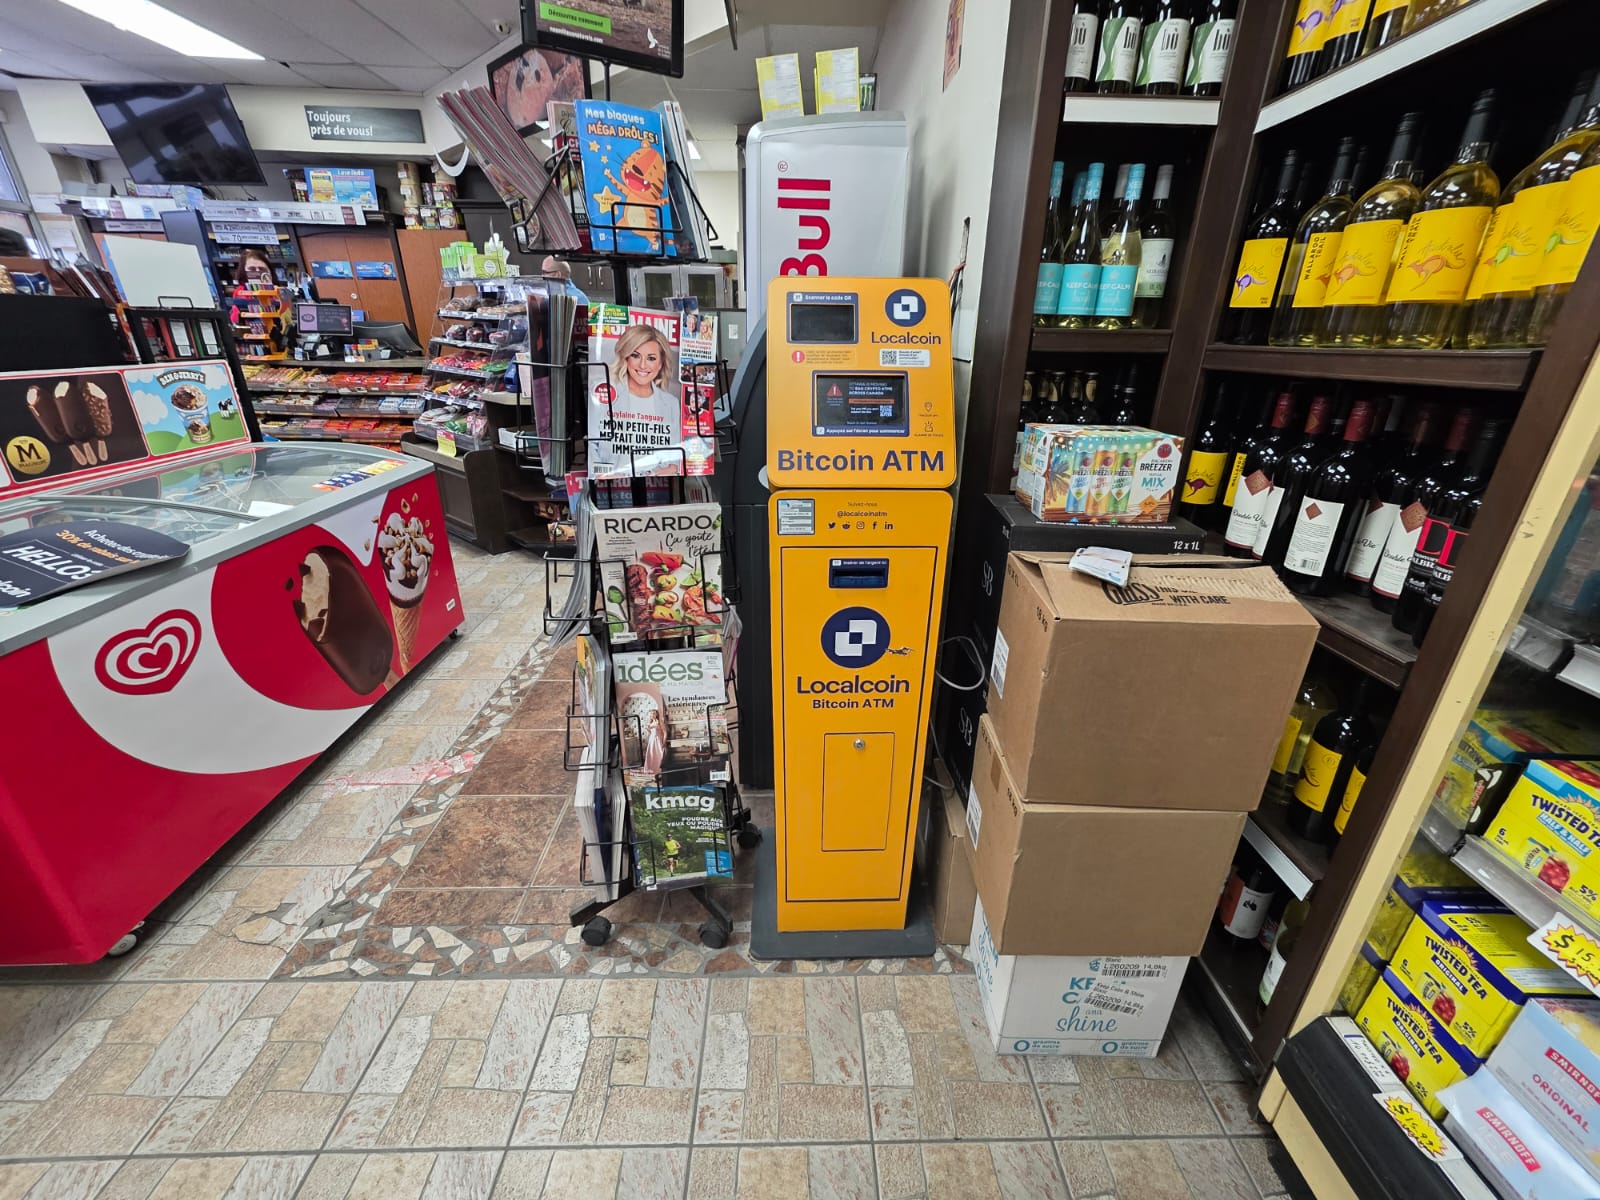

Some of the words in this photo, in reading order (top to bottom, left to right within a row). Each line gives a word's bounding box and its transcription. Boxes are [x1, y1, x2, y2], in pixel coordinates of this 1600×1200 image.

[307, 110, 351, 125] Toujours
[585, 108, 605, 119] Mes
[606, 109, 645, 126] blagues
[310, 124, 332, 137] près
[333, 126, 346, 135] de
[347, 126, 373, 137] vous!
[587, 121, 616, 136] MÉGA
[618, 125, 654, 143] DRÔLES
[777, 177, 831, 276] Bull
[871, 331, 942, 345] Localcoin
[626, 421, 671, 434] PETIT-FILS
[614, 432, 632, 444] FAIT
[635, 435, 648, 444] UN
[650, 435, 670, 446] BIEN
[13, 443, 42, 462] M
[777, 449, 874, 471] Bitcoin
[882, 450, 944, 471] ATM
[1139, 462, 1173, 473] BREEZER
[1140, 476, 1166, 488] MIX
[604, 515, 713, 534] RICARDO
[56, 529, 80, 547] 30%
[665, 532, 683, 552] Ça
[1173, 540, 1183, 550] 12
[1190, 540, 1200, 550] 1L
[1169, 594, 1200, 604] WITH
[1199, 595, 1231, 605] CARE
[618, 656, 704, 683] idées
[796, 674, 910, 694] Localcoin
[812, 698, 859, 709] Bitcoin
[862, 698, 894, 708] ATM
[645, 793, 716, 812] kmag
[1531, 794, 1590, 834] TWISTED
[1587, 829, 1600, 848] TE
[1498, 827, 1507, 836] 6
[1539, 812, 1560, 834] HALF
[1567, 832, 1590, 854] HALF
[1580, 885, 1598, 900] 5%
[1553, 933, 1575, 949] $
[1425, 935, 1467, 978] TWISTED
[1466, 975, 1489, 1000] TEA
[1435, 958, 1466, 993] ORIGINAL
[1056, 1006, 1118, 1032] shine
[1386, 997, 1426, 1042] TWISTED
[1423, 1039, 1443, 1065] TEA
[1395, 1020, 1423, 1056] ORIGINAL
[1462, 1021, 1477, 1038] 5%
[1550, 1051, 1600, 1099] SMIRNOF
[1414, 1081, 1428, 1097] 5%
[1532, 1073, 1591, 1133] ORIGINAL
[1482, 1110, 1536, 1167] SMIRNOFF
